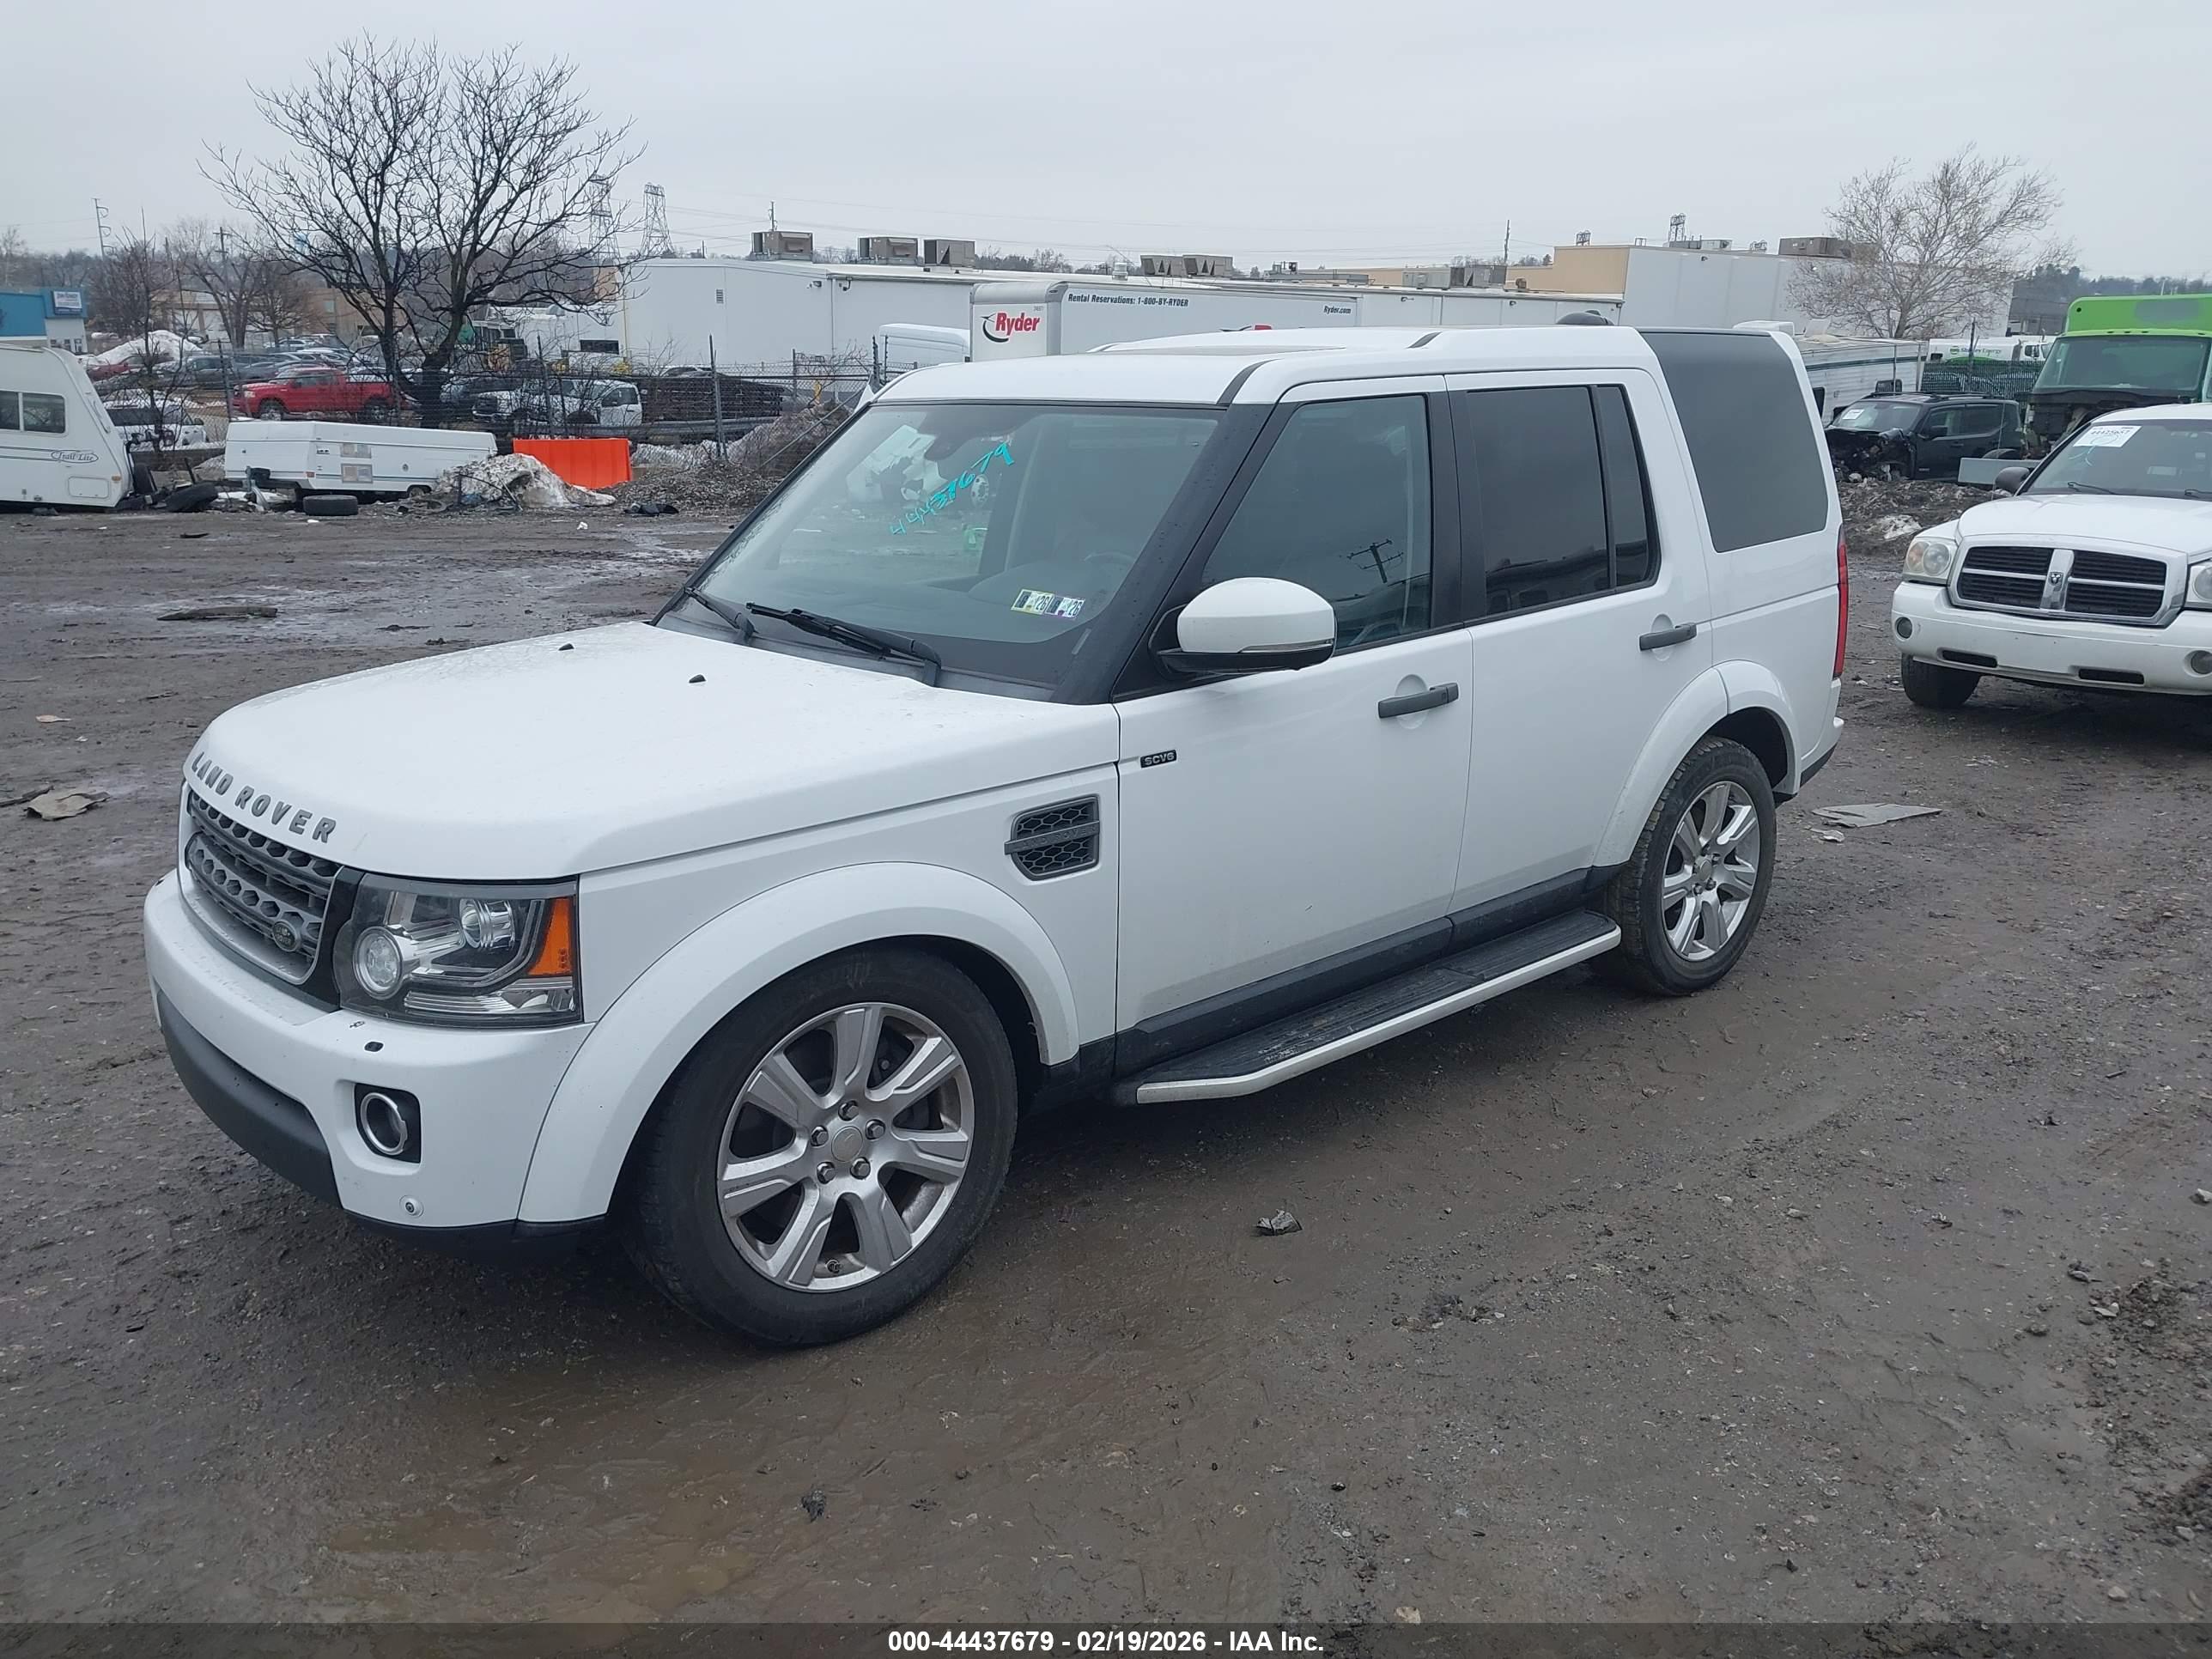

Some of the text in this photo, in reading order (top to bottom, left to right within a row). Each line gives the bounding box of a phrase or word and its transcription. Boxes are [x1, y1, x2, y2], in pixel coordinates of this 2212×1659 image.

[1068, 294, 1189, 307] Rental Reservations: 1-800-BY-RYDER
[1323, 305, 1352, 314] Ryder.com
[995, 313, 1040, 336] Ryder
[890, 442, 1014, 536] 44437679
[1145, 752, 1175, 765] SCV6
[191, 751, 337, 844] LAND ROVER
